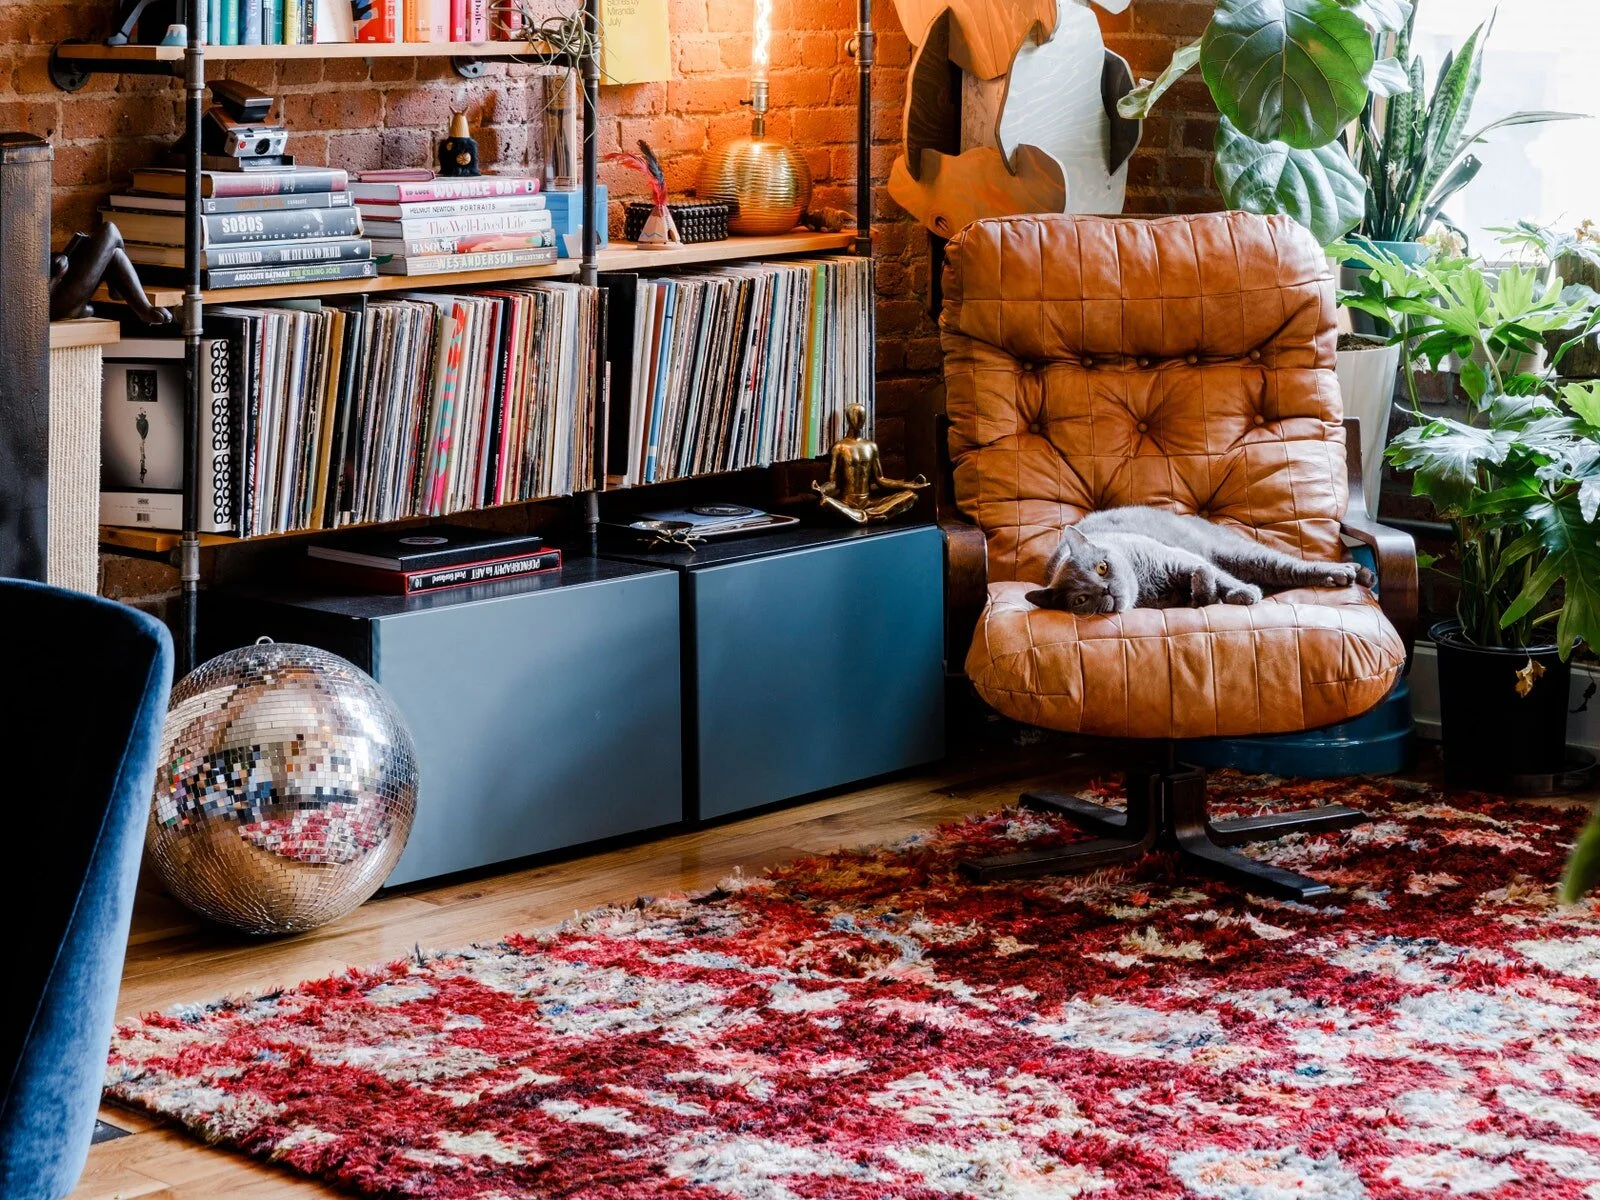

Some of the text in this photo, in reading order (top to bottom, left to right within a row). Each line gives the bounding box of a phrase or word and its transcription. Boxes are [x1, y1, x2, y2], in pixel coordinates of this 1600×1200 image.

[306, 3, 314, 28] WELSH
[474, 0, 482, 26] Dolls
[607, 7, 635, 16] Miranda
[608, 17, 622, 28] July
[434, 179, 521, 198] WUVABLE OAF
[409, 203, 496, 214] HELMUT NEWTON PORTRAITS
[426, 216, 527, 235] The Well-Lived Life
[242, 232, 286, 241] PATRICK
[280, 246, 341, 261] THE EYE HAS TO TRAVEL
[437, 257, 460, 271] WES
[459, 252, 514, 268] ANDERSON
[234, 267, 341, 282] ABSOLUTE BATMAN THE KILLING JOKE
[211, 340, 229, 359] 69
[211, 357, 229, 377] 69
[211, 374, 229, 394] 69
[212, 397, 230, 417] 69
[212, 414, 230, 434] 69
[212, 431, 230, 451] 69
[213, 453, 231, 474] 69
[213, 470, 231, 491] 69
[213, 487, 231, 508] 69
[214, 505, 232, 525] 69
[471, 566, 486, 580] ART
[485, 566, 493, 576] in
[493, 557, 541, 576] PORNOGRAPHY
